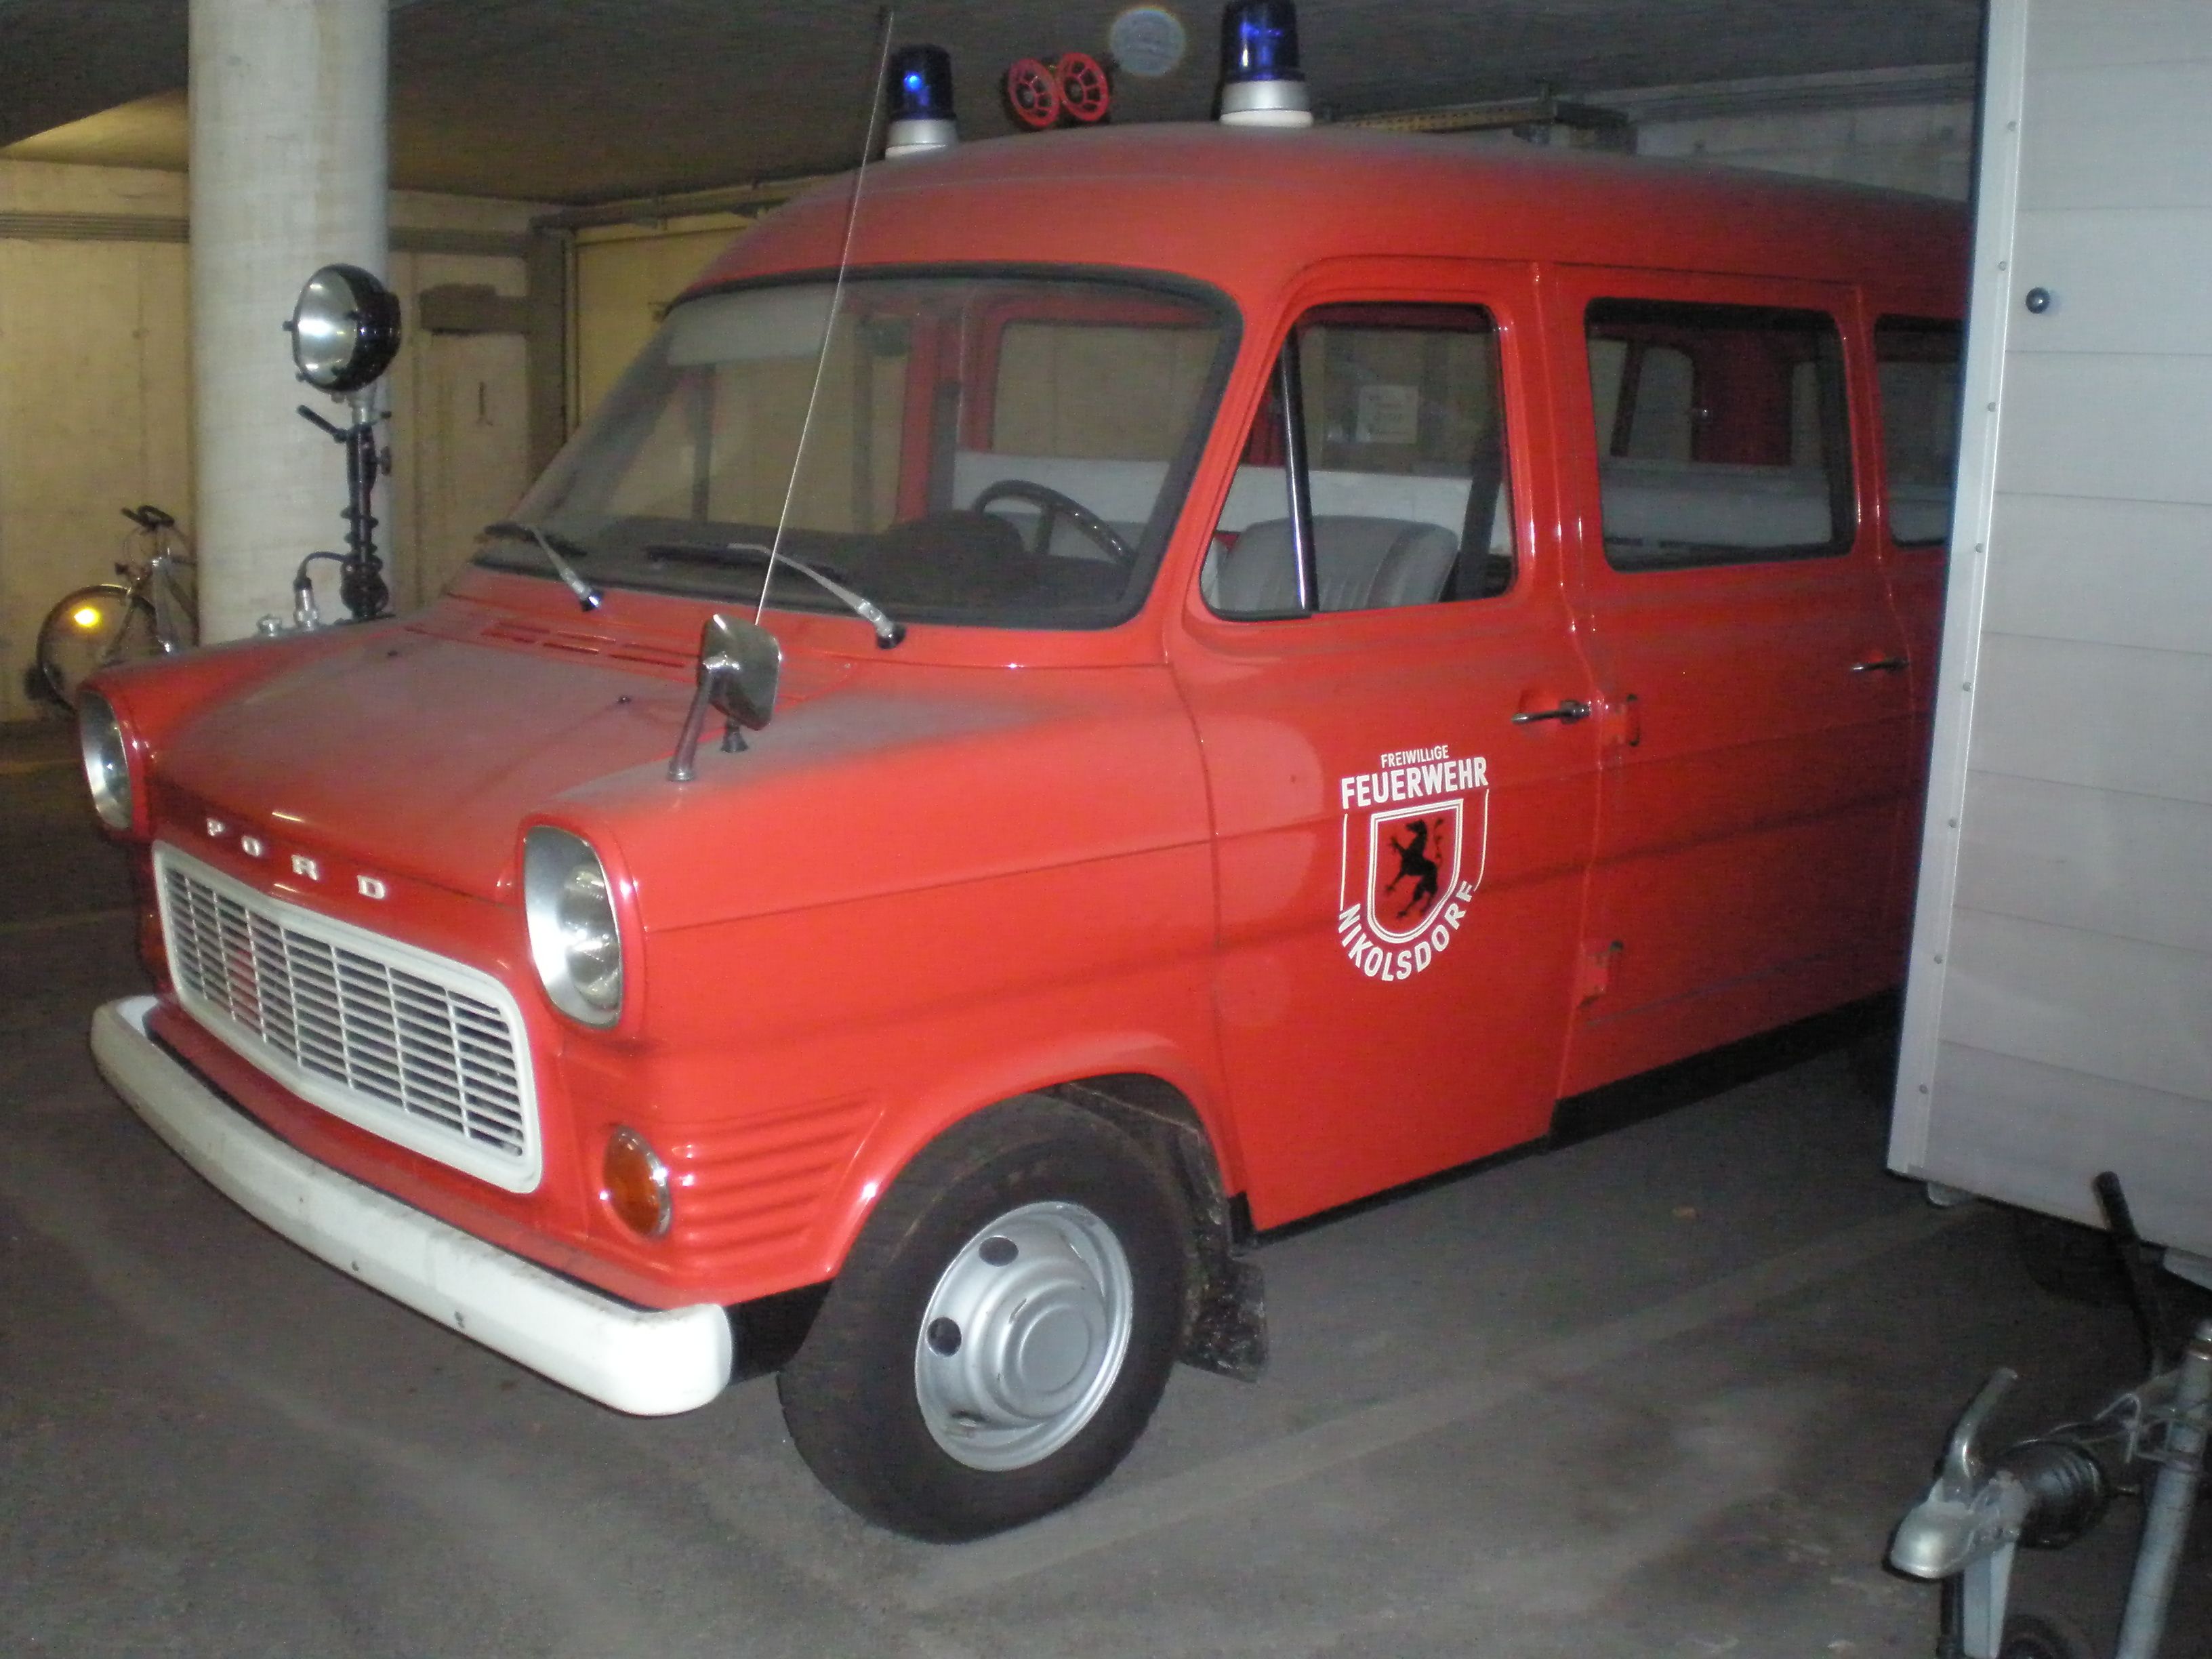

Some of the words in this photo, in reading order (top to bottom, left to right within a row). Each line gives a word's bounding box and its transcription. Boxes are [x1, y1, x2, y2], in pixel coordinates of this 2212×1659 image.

[1341, 757, 1488, 809] FEUERWEHR
[1381, 745, 1449, 769] FREIWILLIGE
[207, 817, 386, 900] FORD
[1338, 880, 1473, 981] NIKOLSDORF
